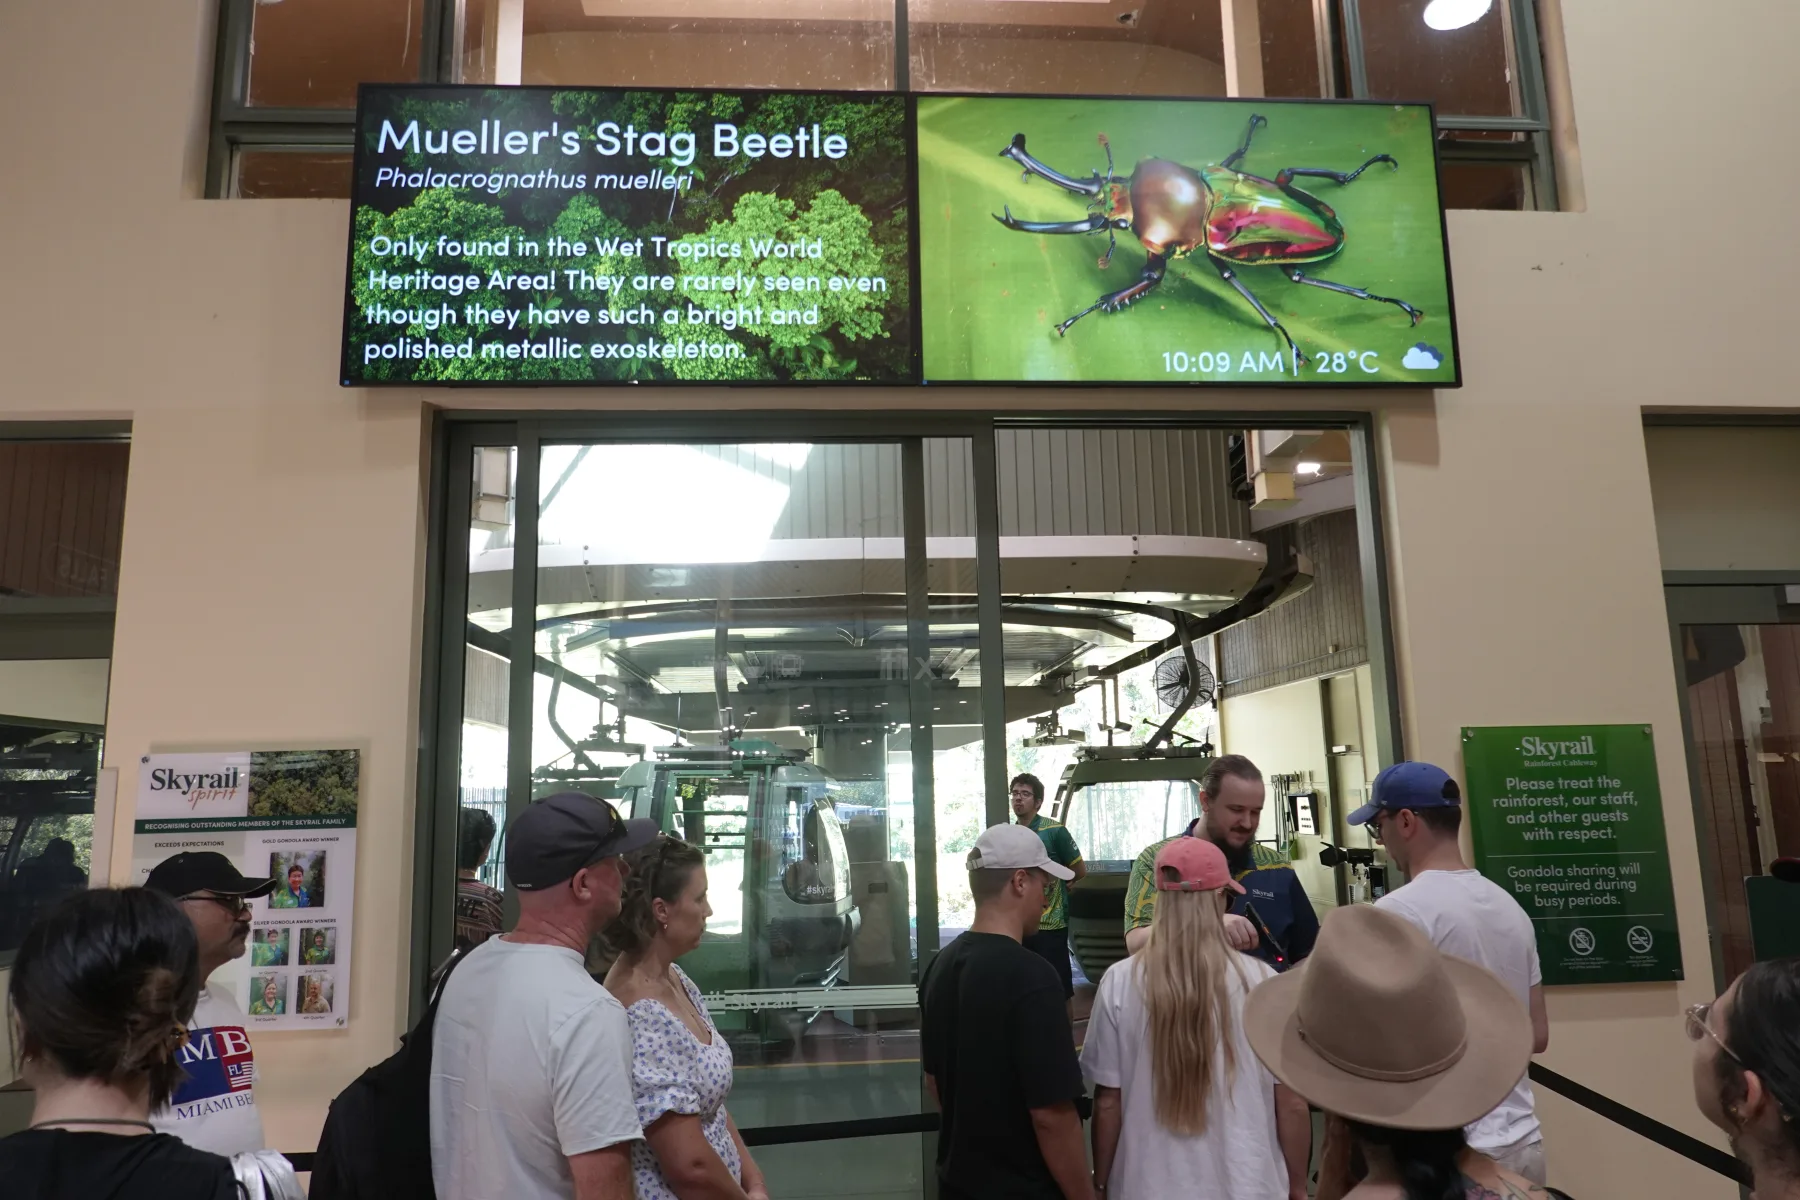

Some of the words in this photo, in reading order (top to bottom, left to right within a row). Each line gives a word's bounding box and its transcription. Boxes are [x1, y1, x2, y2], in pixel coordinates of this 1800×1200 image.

[377, 120, 580, 156] Mueller's
[596, 122, 696, 166] Stag
[713, 124, 848, 159] Beetle
[375, 167, 587, 193] Phalacrognathus
[595, 170, 693, 191] muelleri
[371, 236, 428, 262] Only
[437, 236, 511, 258] found
[518, 236, 538, 257] in
[547, 236, 587, 258] the
[595, 237, 643, 258] Wet
[651, 237, 741, 265] Tropics
[750, 237, 822, 259] World
[369, 270, 480, 297] Heritage
[488, 270, 556, 291] Area!
[564, 270, 628, 297] They
[635, 275, 674, 292] are
[683, 270, 756, 297] rarely
[764, 276, 820, 292] seen
[828, 277, 886, 293] even
[366, 304, 457, 331] though
[465, 304, 518, 331] they
[528, 304, 590, 325] have
[598, 304, 654, 326] such
[663, 309, 679, 325] a
[687, 304, 762, 331] bright
[770, 305, 818, 325] and
[364, 336, 472, 365] polished
[481, 336, 582, 360] metallic
[591, 337, 746, 361] exoskeleton.
[1162, 351, 1230, 373] 10:09
[1239, 352, 1284, 373] AM
[1315, 351, 1379, 374] 28°C
[1521, 735, 1594, 760] Skyrail
[1563, 760, 1598, 768] Cableway
[150, 766, 239, 795] Skyrail
[1506, 777, 1555, 790] Please
[1558, 777, 1594, 790] treat
[1597, 776, 1621, 789] the
[188, 787, 237, 811] spirit
[1493, 794, 1568, 808] rainforest,
[1572, 796, 1596, 806] our
[1600, 792, 1638, 806] staff,
[144, 822, 190, 830] RECOGNISING
[190, 820, 237, 829] OUTSTANDING
[238, 820, 270, 828] MEMBERS
[1506, 812, 1535, 825] and
[1539, 811, 1577, 824] other
[1582, 811, 1629, 826] guests
[1523, 828, 1554, 841] with
[1558, 828, 1617, 843] respect.
[1507, 865, 1564, 879] Gondola
[1567, 864, 1616, 879] sharing
[1619, 863, 1641, 875] will
[1252, 889, 1274, 897] Skyrail
[1515, 881, 1532, 893] be
[1535, 880, 1591, 895] required
[1594, 879, 1637, 893] during
[1535, 895, 1565, 908] busy
[1569, 894, 1621, 909] periods.
[227, 1064, 243, 1076] FL
[176, 1097, 234, 1120] MIAMI
